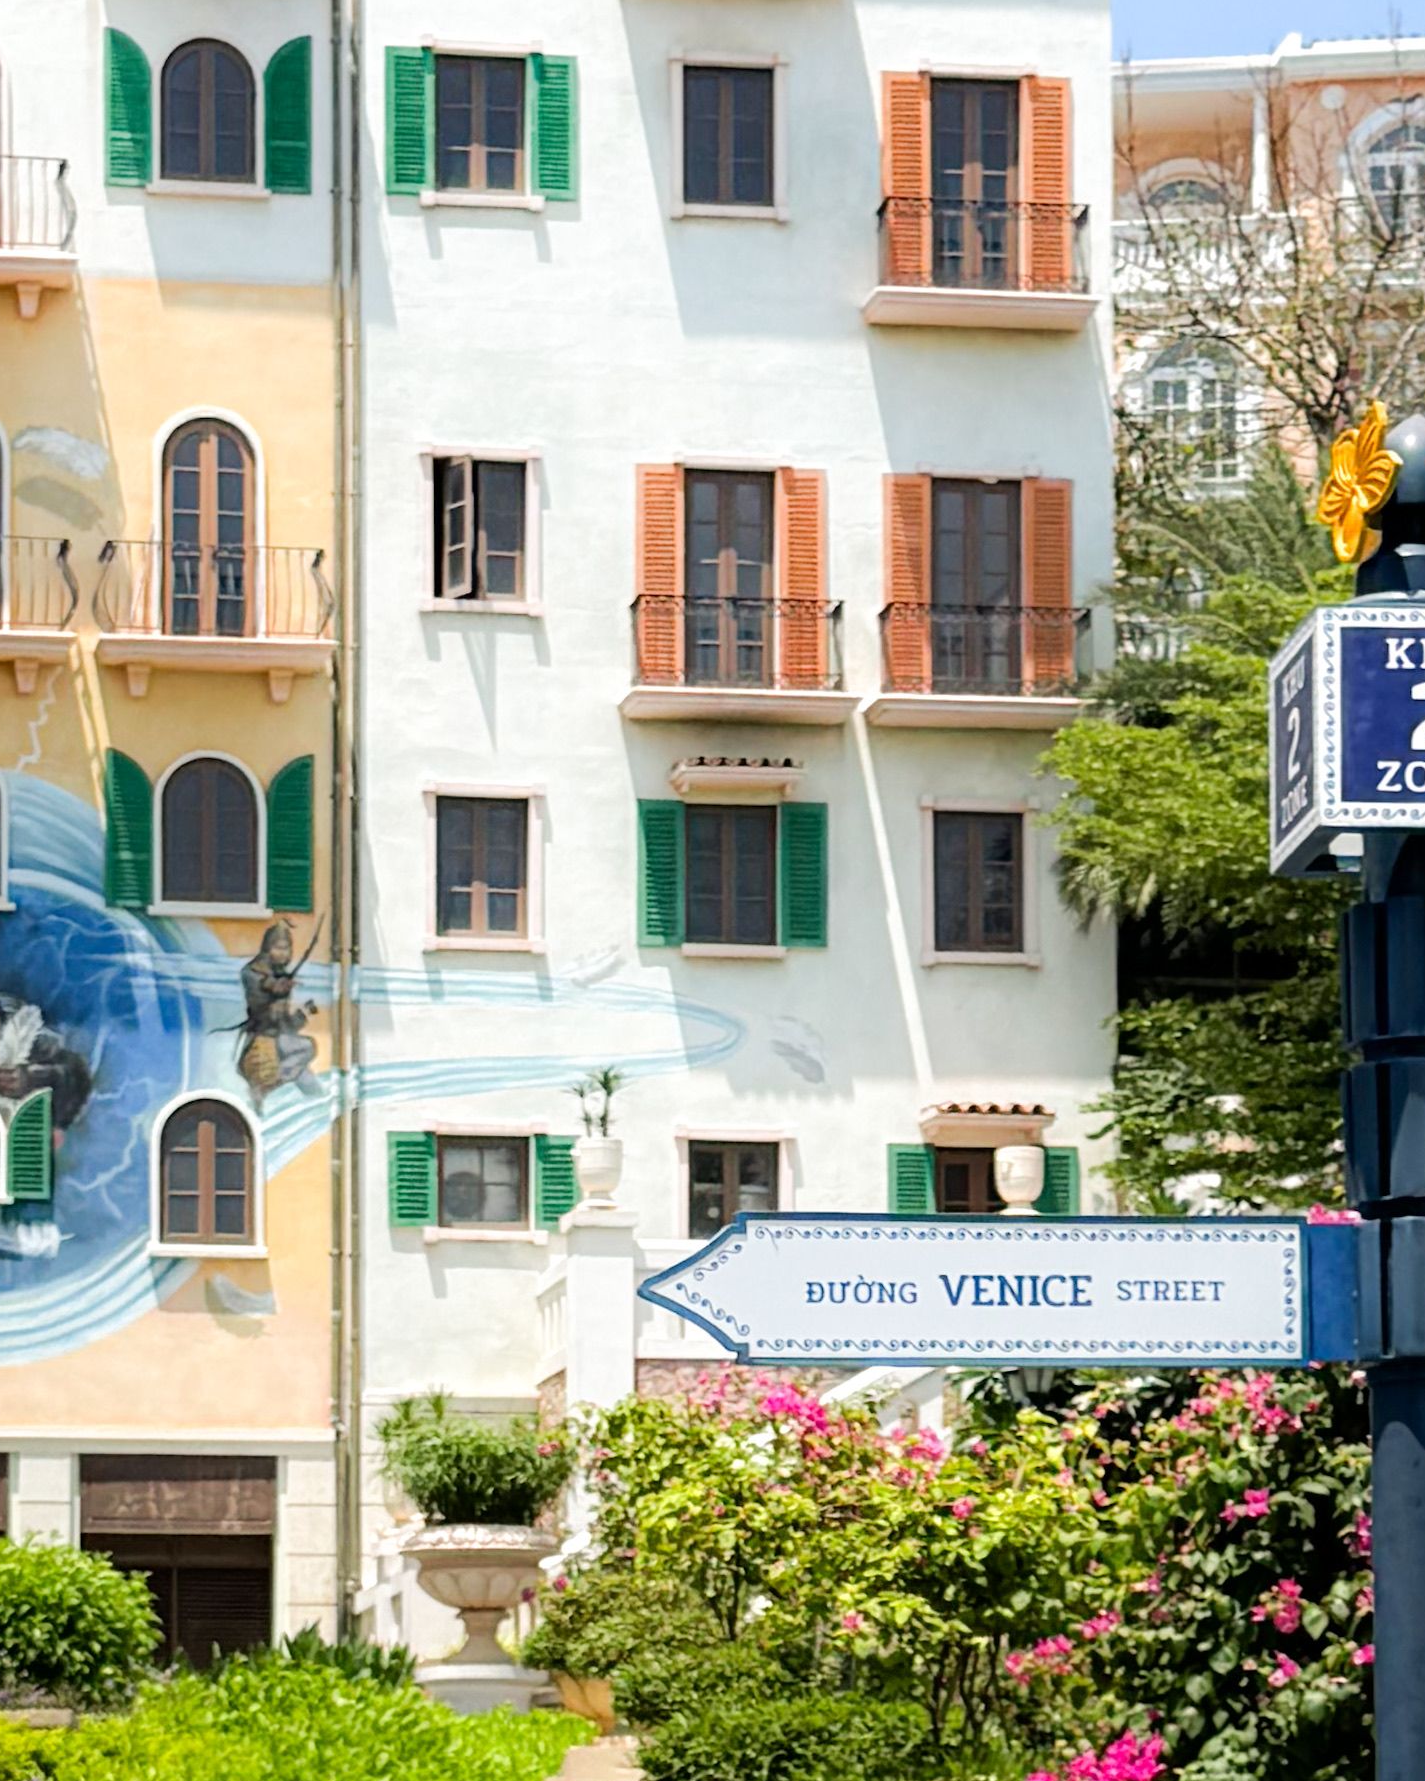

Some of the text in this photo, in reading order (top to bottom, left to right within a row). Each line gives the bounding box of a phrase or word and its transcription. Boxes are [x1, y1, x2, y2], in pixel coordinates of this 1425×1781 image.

[1287, 707, 1301, 782] 2
[805, 1274, 1227, 1308] ĐƯỜNG VENICE STREET
